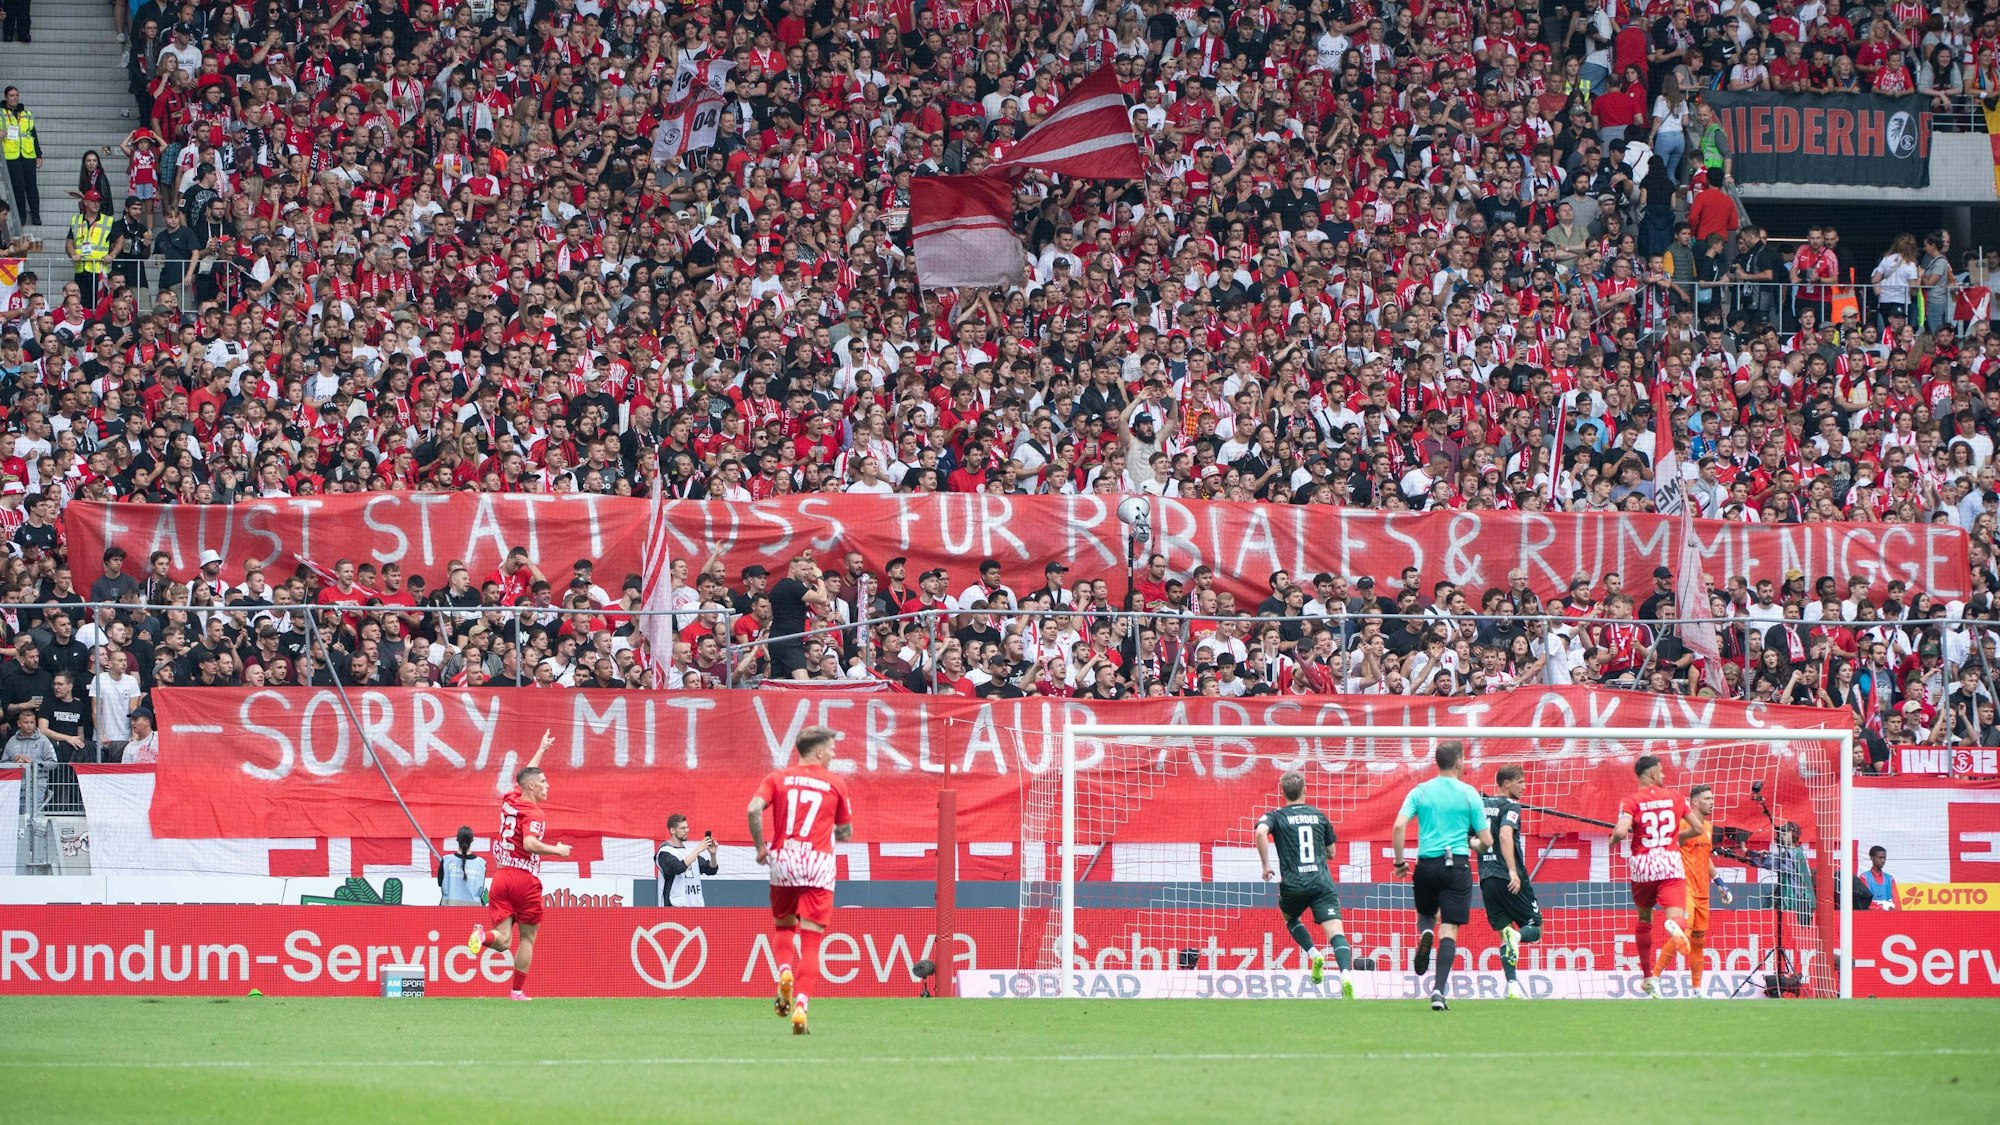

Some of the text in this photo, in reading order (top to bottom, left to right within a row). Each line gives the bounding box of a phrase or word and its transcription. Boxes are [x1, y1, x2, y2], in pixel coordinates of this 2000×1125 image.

[102, 498, 323, 571] FAUST
[363, 493, 613, 566] STATT
[660, 498, 844, 556] KUSS
[1444, 511, 1484, 587] &
[570, 693, 716, 769] MIT
[752, 696, 1105, 776] VERLAUB
[1155, 700, 1490, 779] ABSOLUT
[1531, 691, 1716, 772] OKAY
[1970, 749, 1998, 774] 12
[786, 788, 822, 837] 17
[1287, 814, 1319, 825] WERDER
[1641, 810, 1676, 848] 32
[1298, 825, 1315, 864] 8
[1928, 888, 1988, 905] LOTTO
[1, 929, 514, 982] Rundum-Service
[988, 973, 1141, 998] JOBRAD
